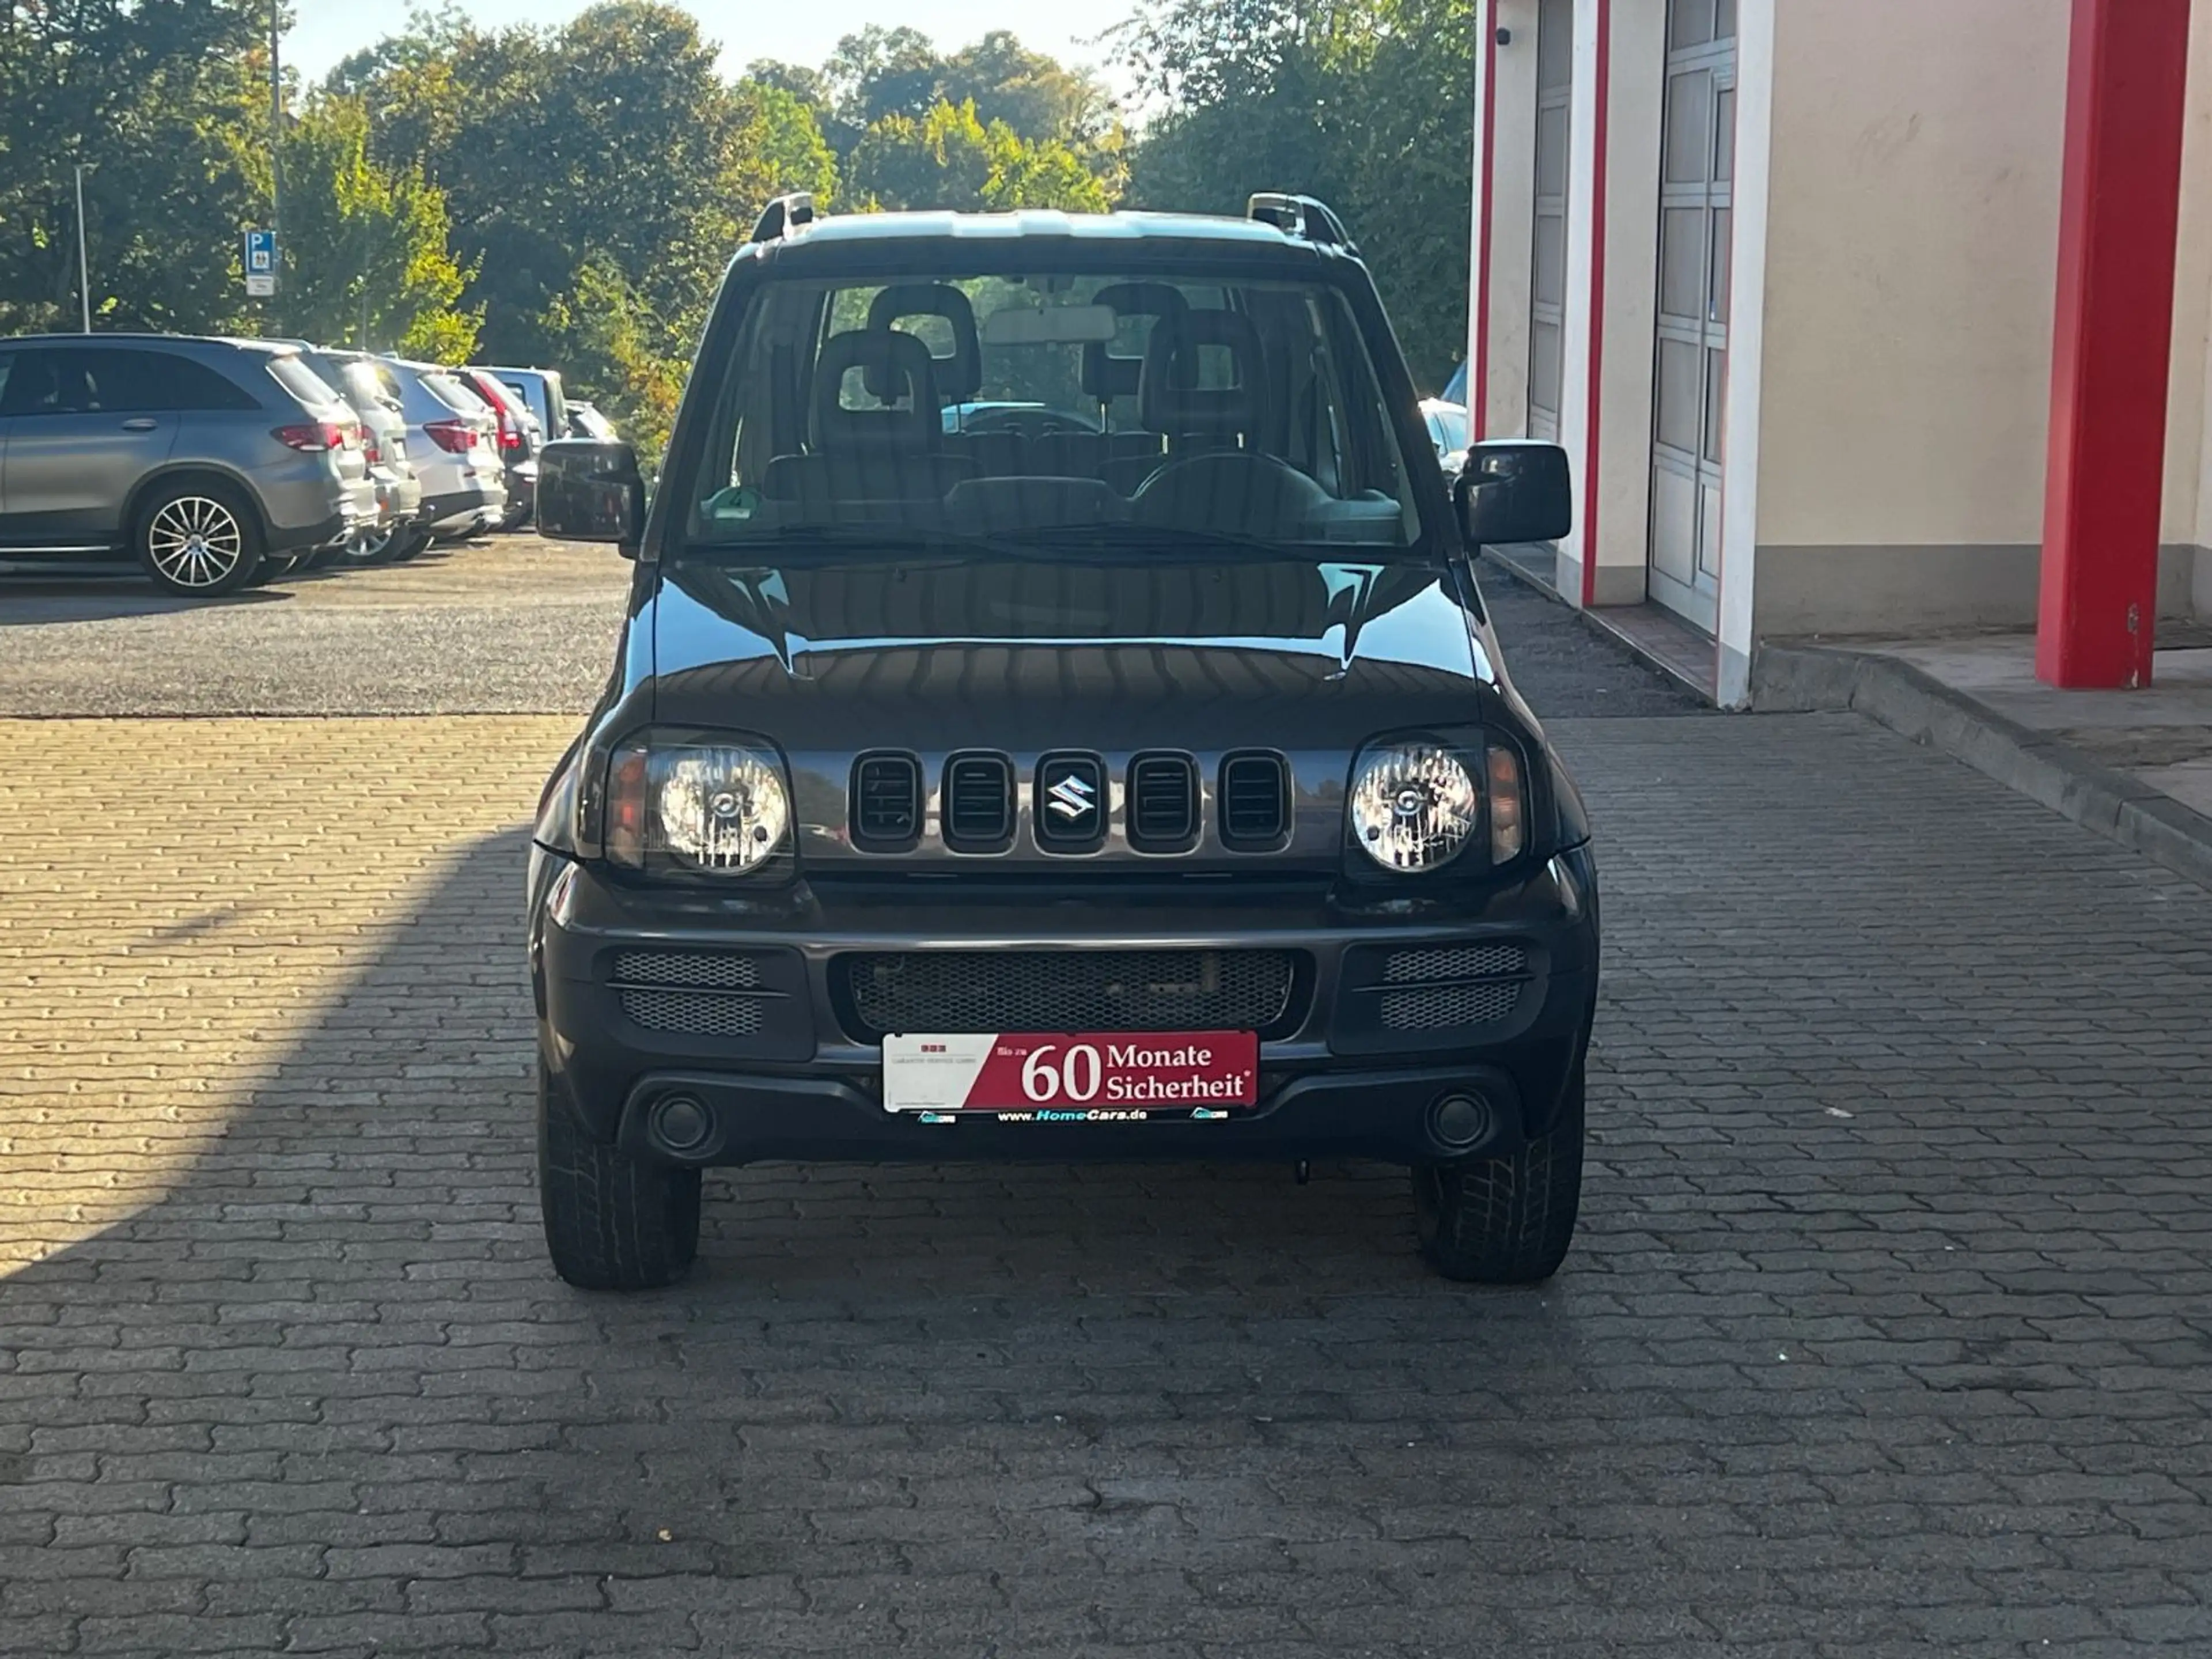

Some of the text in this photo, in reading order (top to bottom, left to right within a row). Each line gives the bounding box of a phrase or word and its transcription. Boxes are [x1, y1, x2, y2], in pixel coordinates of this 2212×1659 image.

[252, 233, 263, 250] P
[729, 490, 742, 506] 4
[1107, 1044, 1212, 1068] Monate
[1022, 1044, 1101, 1101] 60
[998, 1109, 1147, 1121] www.HomeCars.de
